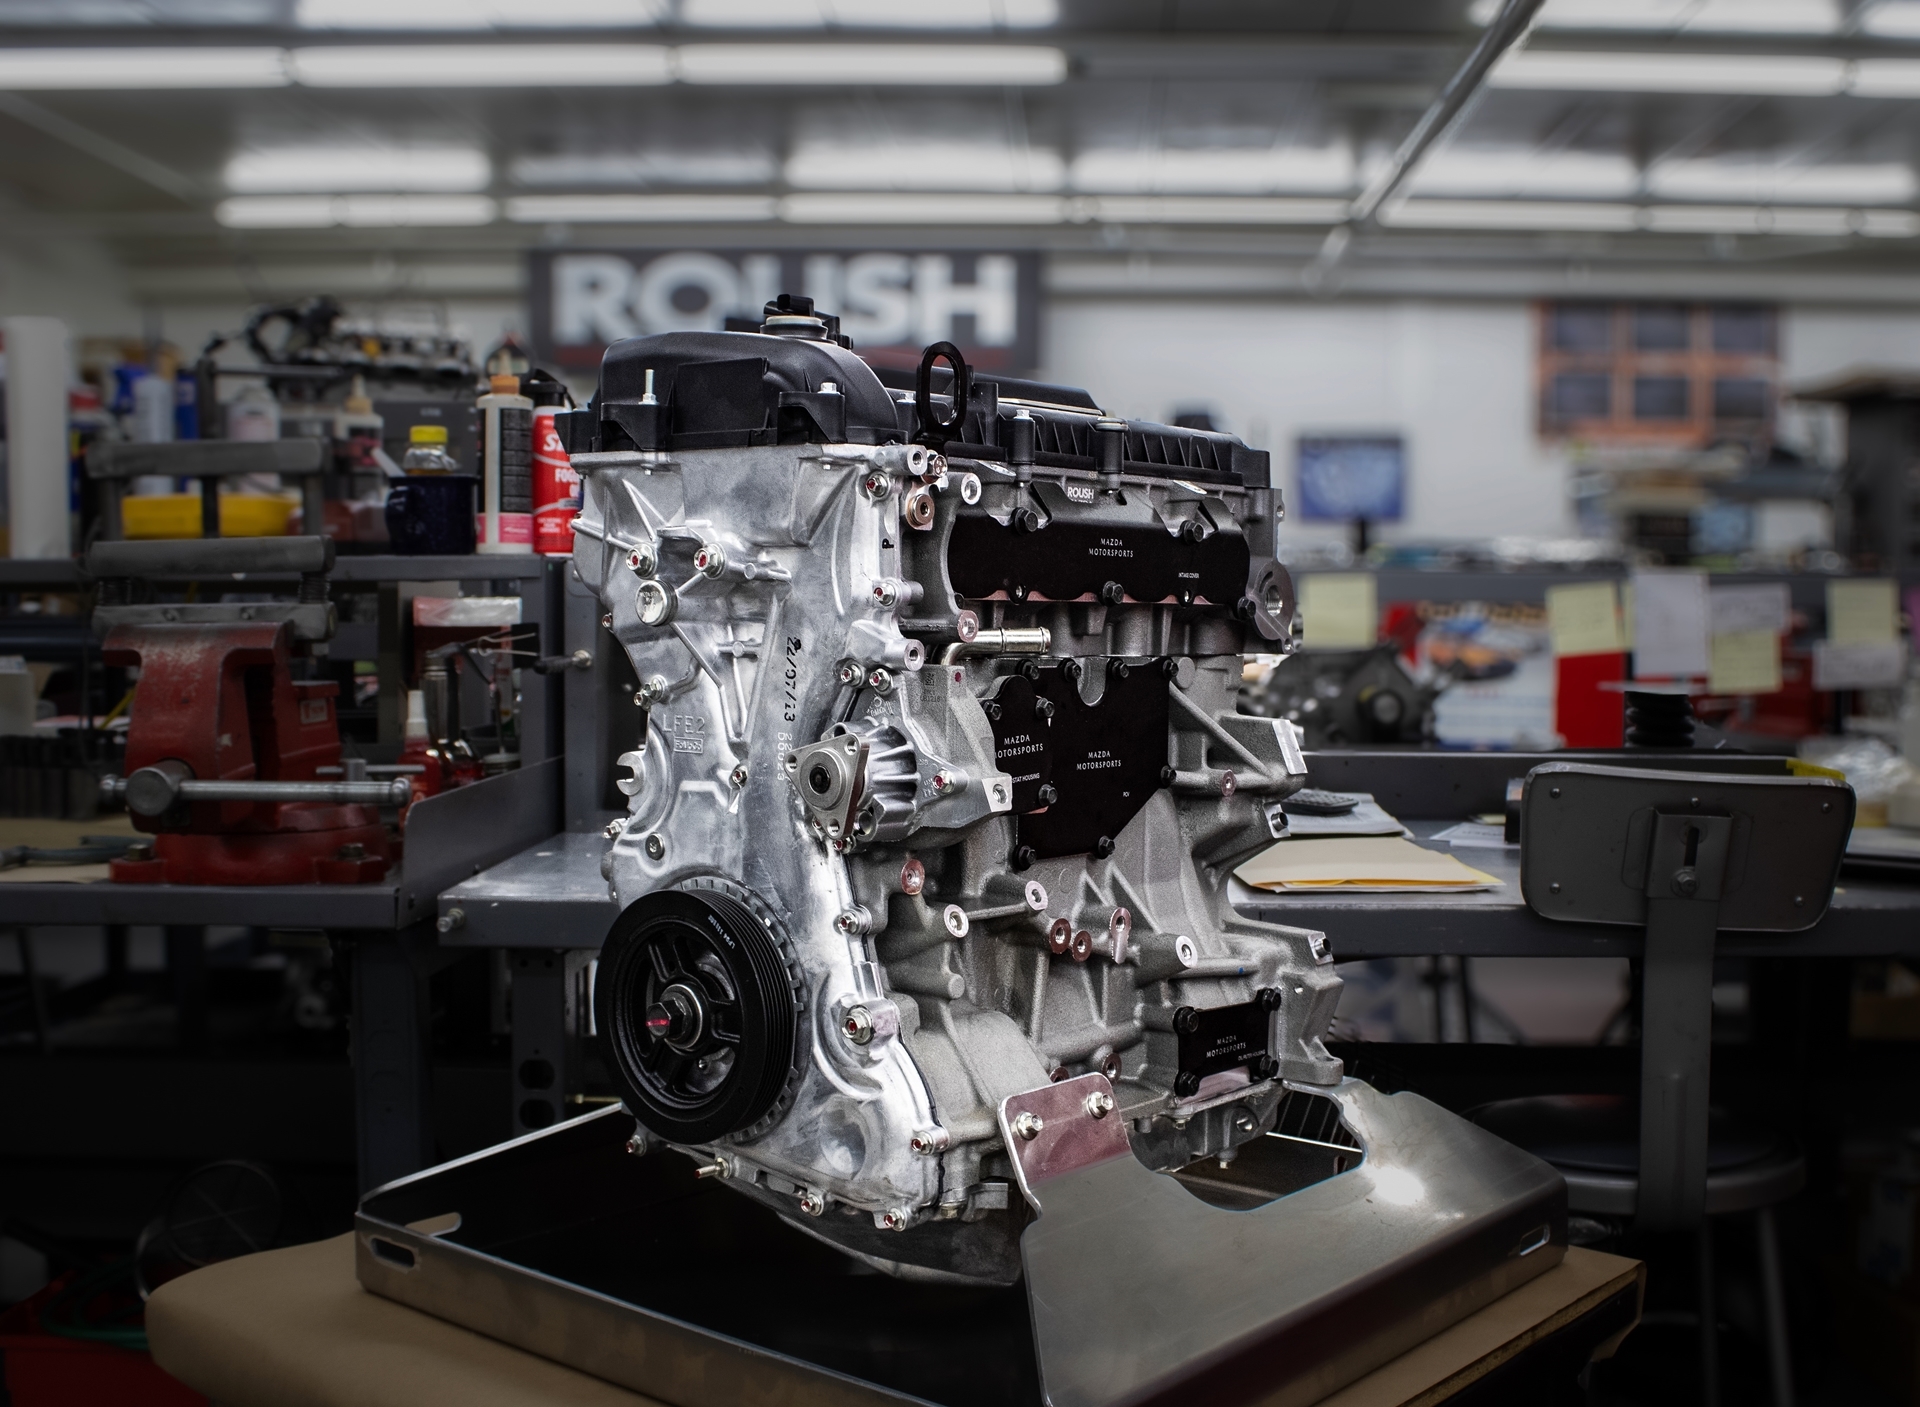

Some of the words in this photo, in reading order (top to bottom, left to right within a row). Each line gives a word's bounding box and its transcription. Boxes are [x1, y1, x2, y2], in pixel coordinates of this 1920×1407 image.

[551, 252, 1018, 347] ROUSH
[1067, 486, 1095, 499] ROUSH
[1101, 538, 1123, 547] MAZDA
[1088, 548, 1134, 558] MOTORSPORTS
[662, 713, 705, 734] LFE2
[1004, 734, 1031, 745] MAZDA
[995, 743, 1044, 759] OTORSPORTS
[1088, 750, 1111, 759] MAZDA
[1076, 760, 1122, 770] MOTORSPORTS
[1022, 772, 1040, 782] HOUSING
[1217, 1035, 1237, 1045] MAZDA
[1206, 1042, 1247, 1058] MOTORSPORTS
